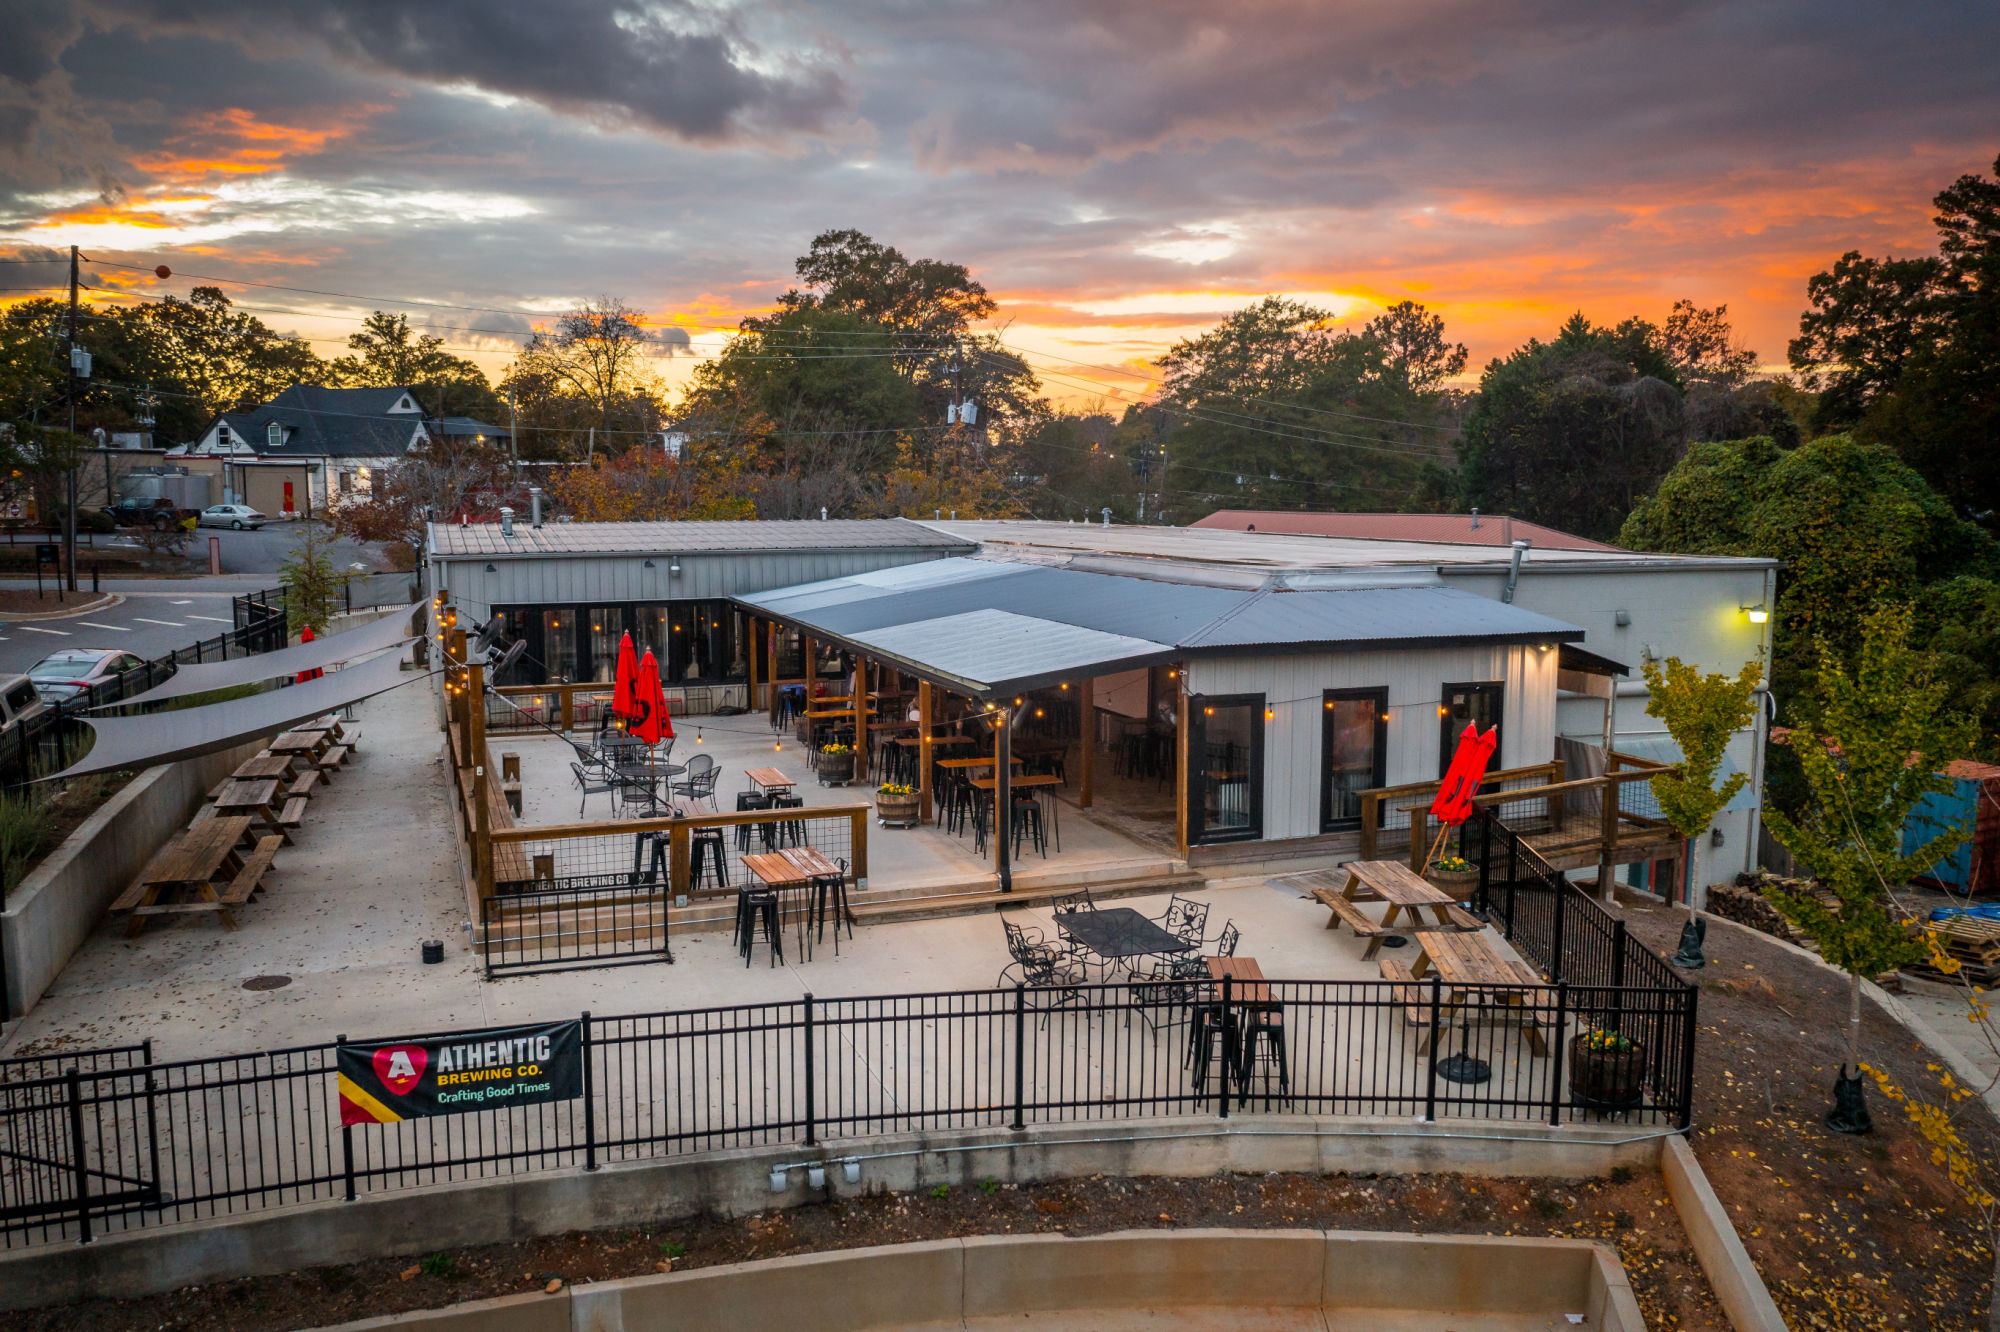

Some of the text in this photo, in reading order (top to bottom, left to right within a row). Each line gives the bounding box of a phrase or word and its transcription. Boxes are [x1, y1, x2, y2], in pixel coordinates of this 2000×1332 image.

[571, 875, 615, 887] BREWING
[616, 874, 629, 885] CO
[437, 1036, 551, 1073] ATHENTIC
[437, 1064, 543, 1086] BREWING CO.
[437, 1082, 551, 1104] Crafting Good Times
